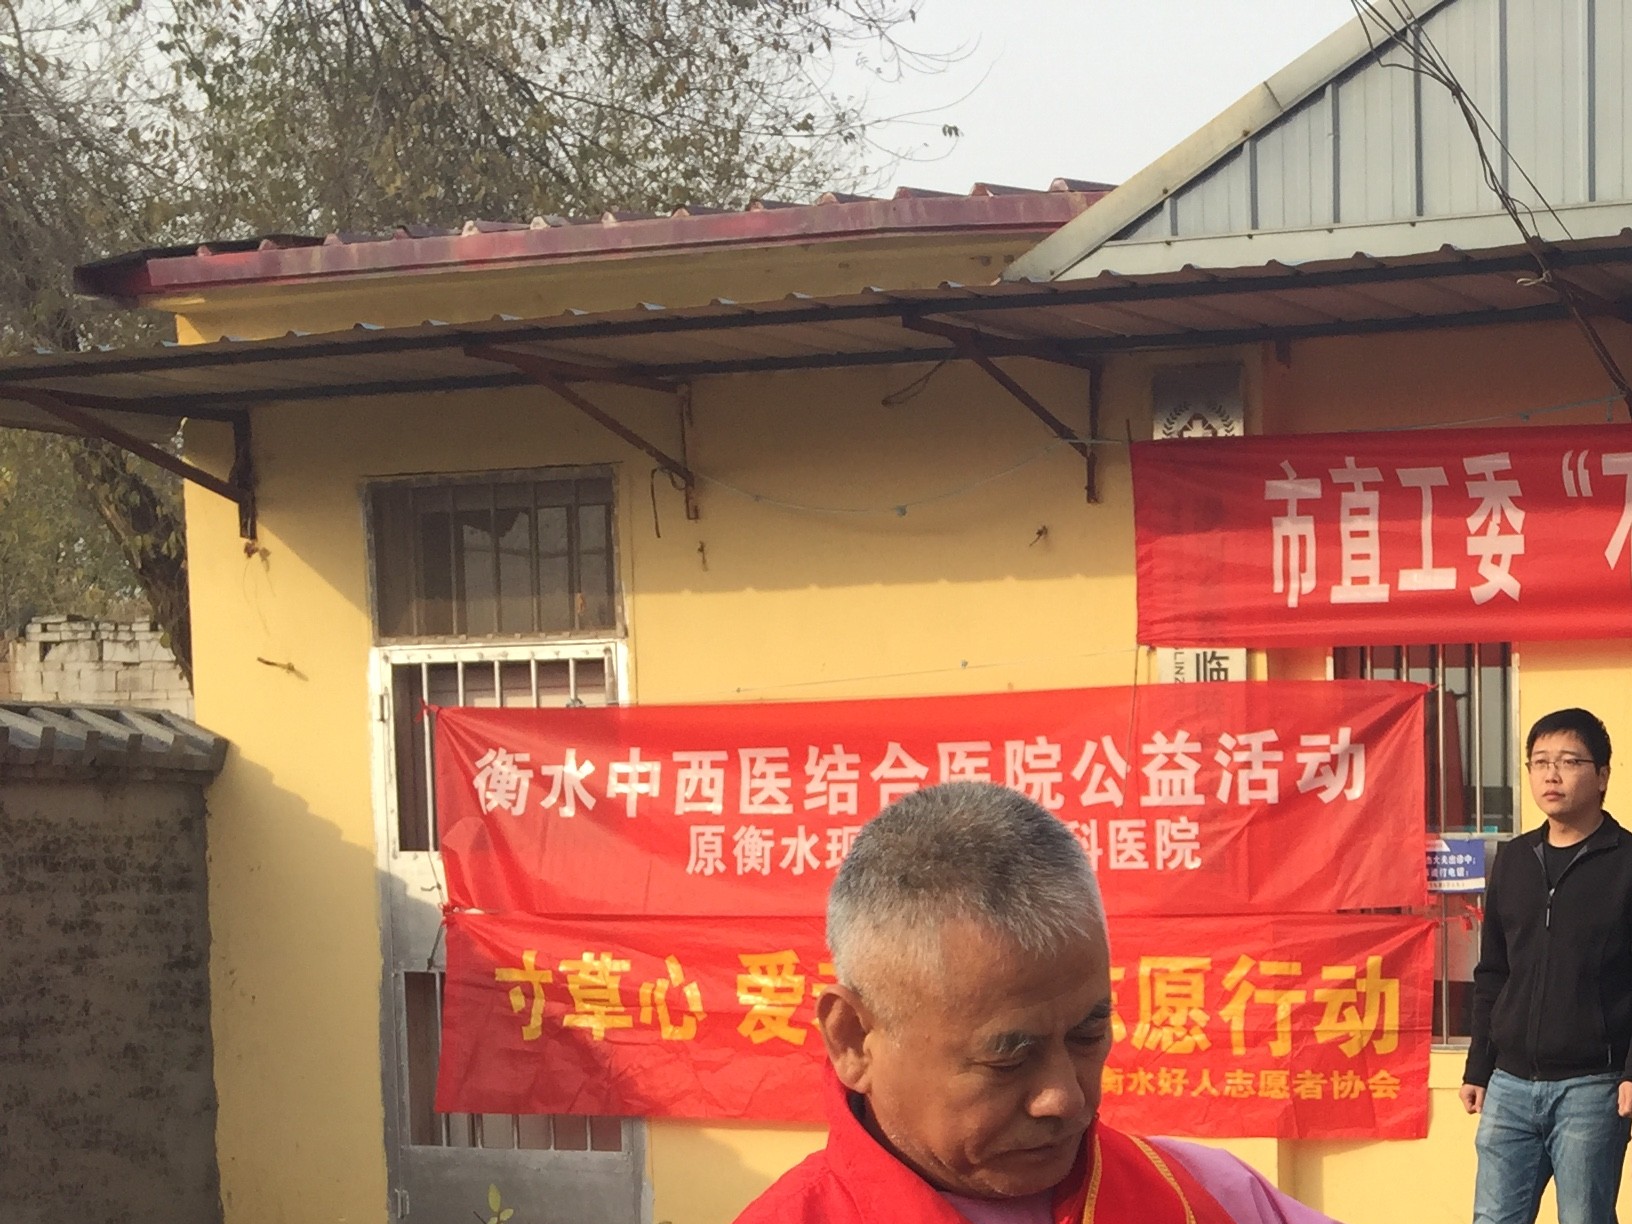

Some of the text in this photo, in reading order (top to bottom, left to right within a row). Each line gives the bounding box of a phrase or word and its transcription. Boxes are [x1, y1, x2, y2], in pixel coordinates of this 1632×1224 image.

[472, 726, 1367, 818] 衡水中西医结合医院公益活动
[494, 949, 707, 1042] 寸草心
[1110, 953, 1400, 1058] 愿行动
